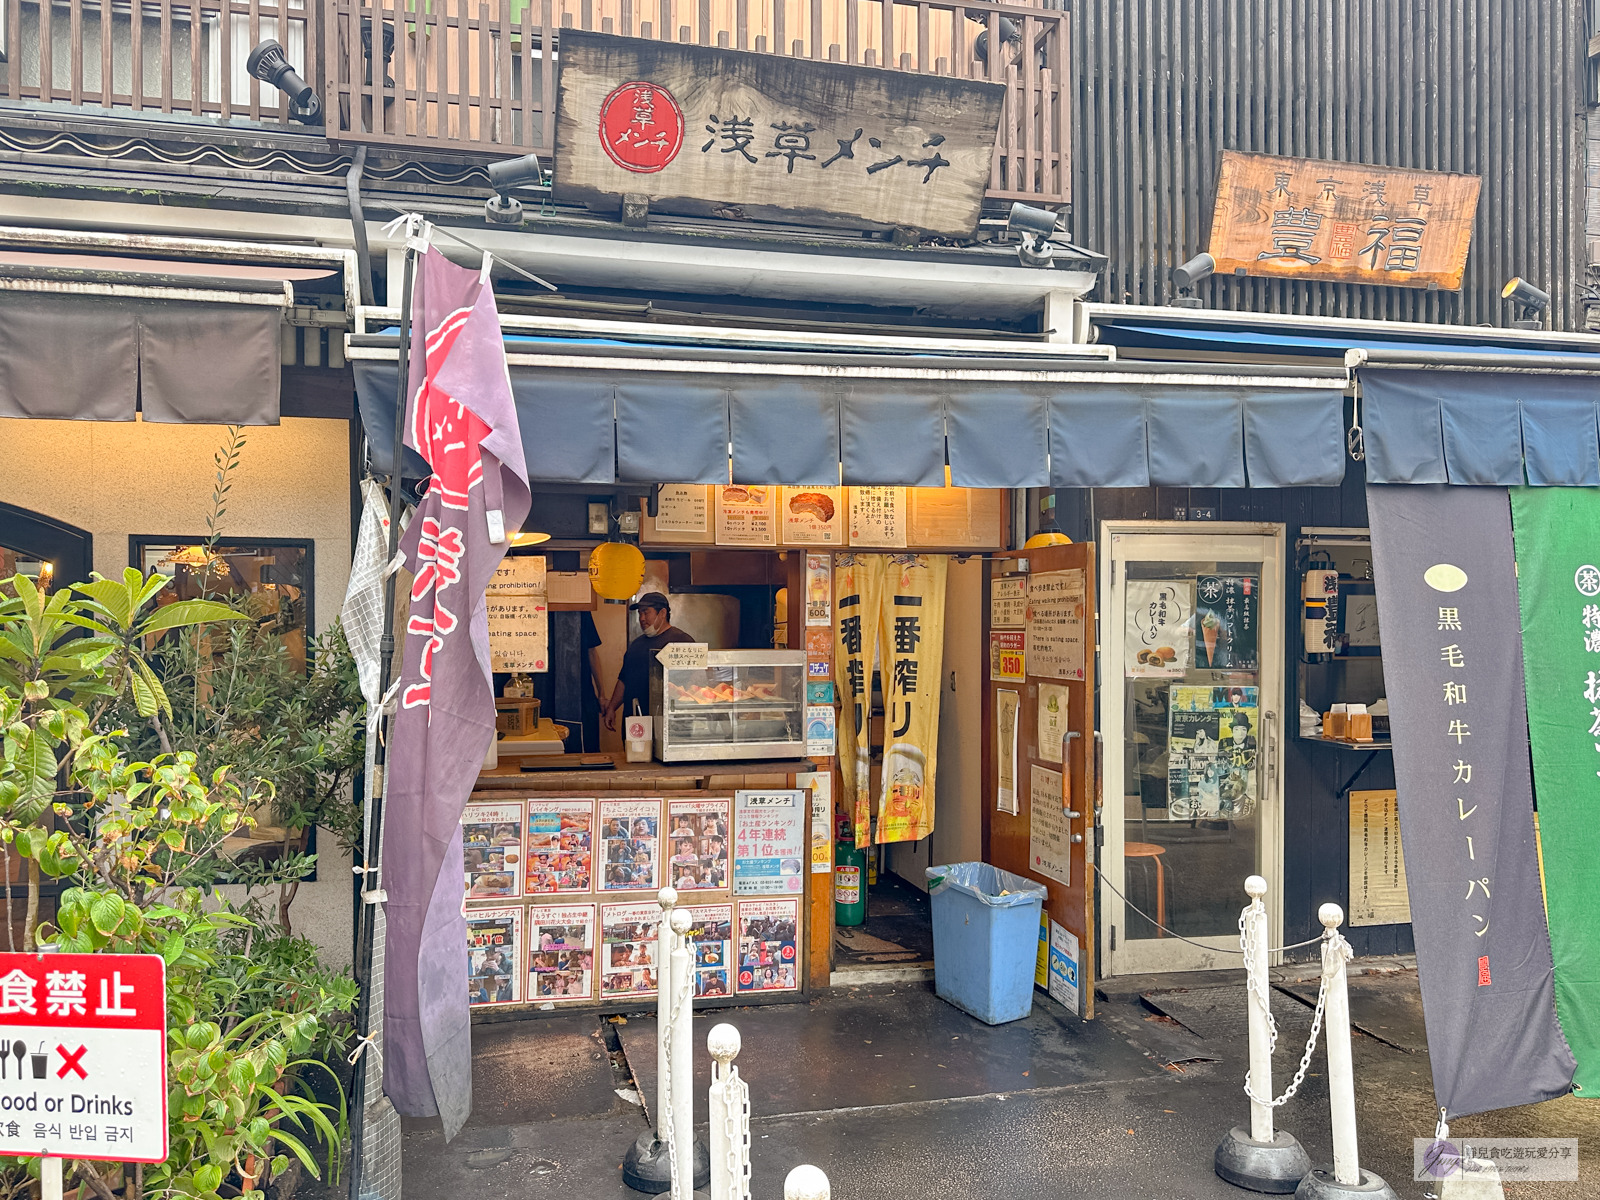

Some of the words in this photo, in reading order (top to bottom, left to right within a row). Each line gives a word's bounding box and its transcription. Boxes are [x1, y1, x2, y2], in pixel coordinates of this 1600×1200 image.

[631, 89, 655, 130] 浅草
[615, 128, 670, 152] メンチ
[702, 113, 950, 184] 浅草メンチ
[1266, 171, 1433, 210] 東京浅草
[1257, 207, 1428, 272] 豊福
[1196, 510, 1211, 519] 3-4
[809, 559, 818, 568] 新
[499, 581, 541, 589] prohibition!
[1203, 581, 1219, 599] 茶
[1579, 570, 1598, 591] 茶
[1158, 592, 1167, 626] 黒毛和牛
[1149, 602, 1158, 639] カレーパン
[893, 595, 922, 739] 一番搾り
[1174, 714, 1219, 723] 東京カレンダー
[1437, 606, 1492, 938] 黒毛和牛カレーパン
[750, 797, 790, 805] 浅草メンチ
[737, 828, 787, 841] 4年連続
[739, 820, 796, 828] 「お土産ランキング」
[0, 969, 137, 1017] 食禁止
[45, 1097, 64, 1113] or
[71, 1094, 133, 1116] Drinks
[33, 1123, 62, 1139] 음식
[69, 1124, 97, 1141] 반입
[104, 1125, 133, 1143] 금지
